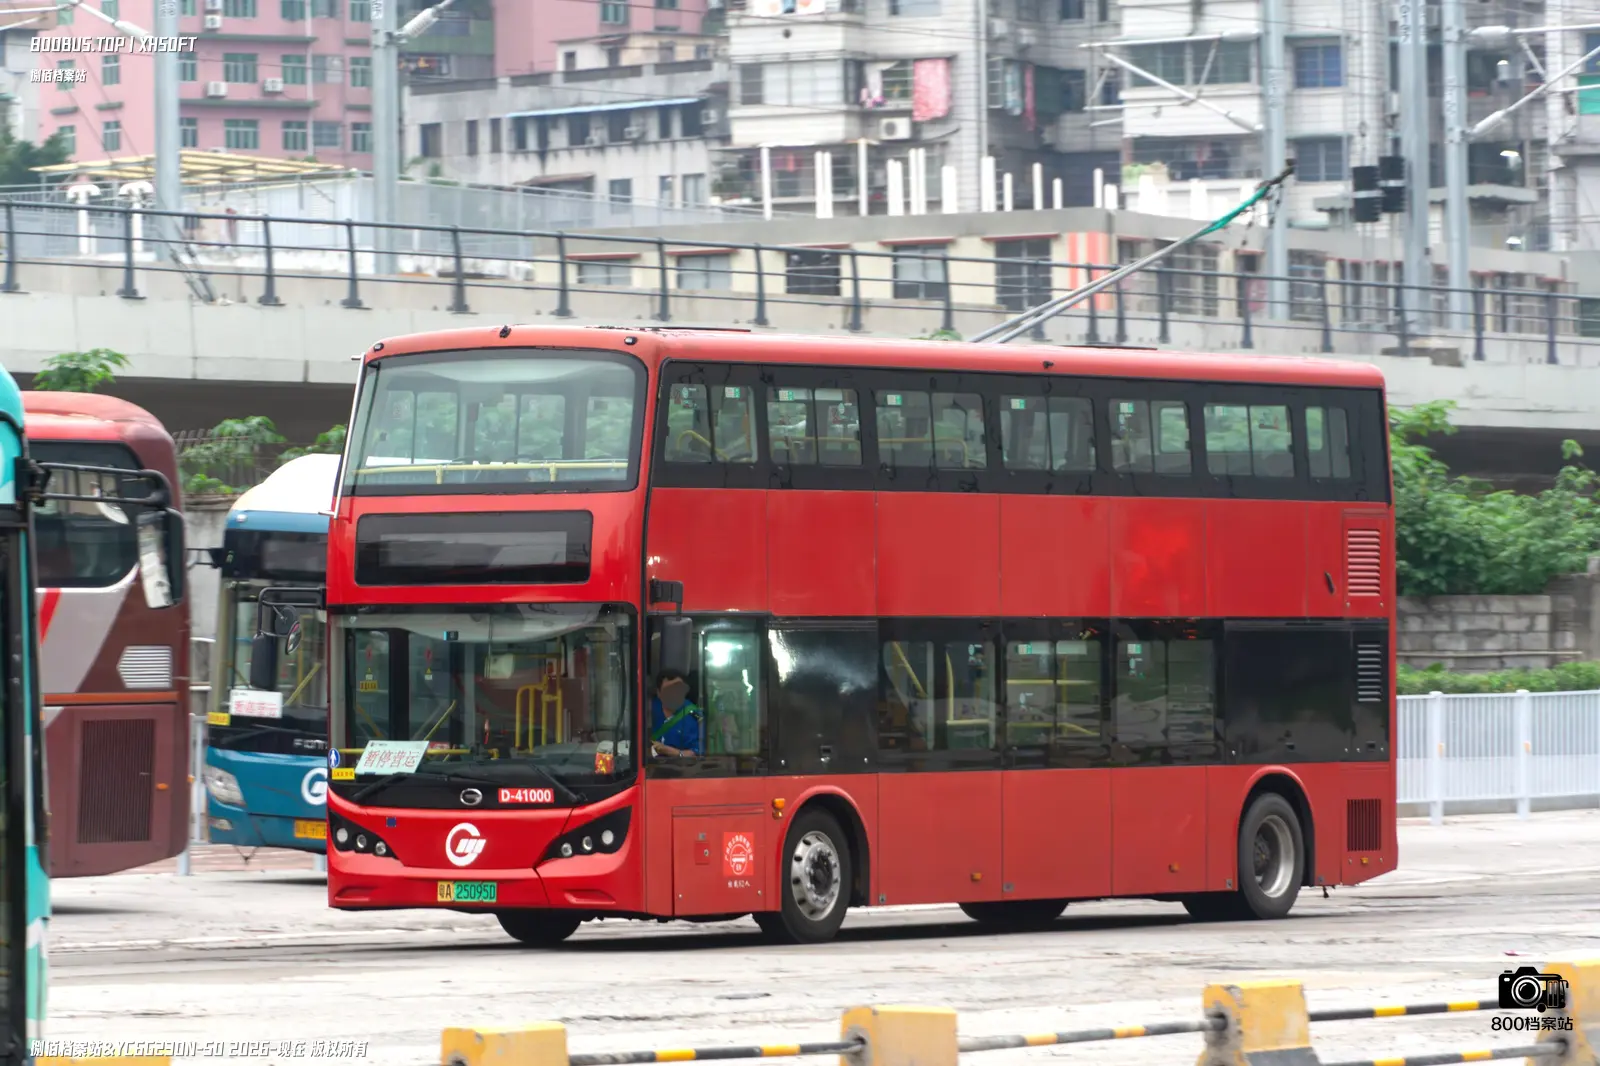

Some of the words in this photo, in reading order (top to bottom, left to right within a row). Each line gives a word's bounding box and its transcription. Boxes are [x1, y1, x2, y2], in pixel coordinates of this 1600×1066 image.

[363, 749, 421, 768] 暂停营运
[500, 788, 552, 803] D-41000
